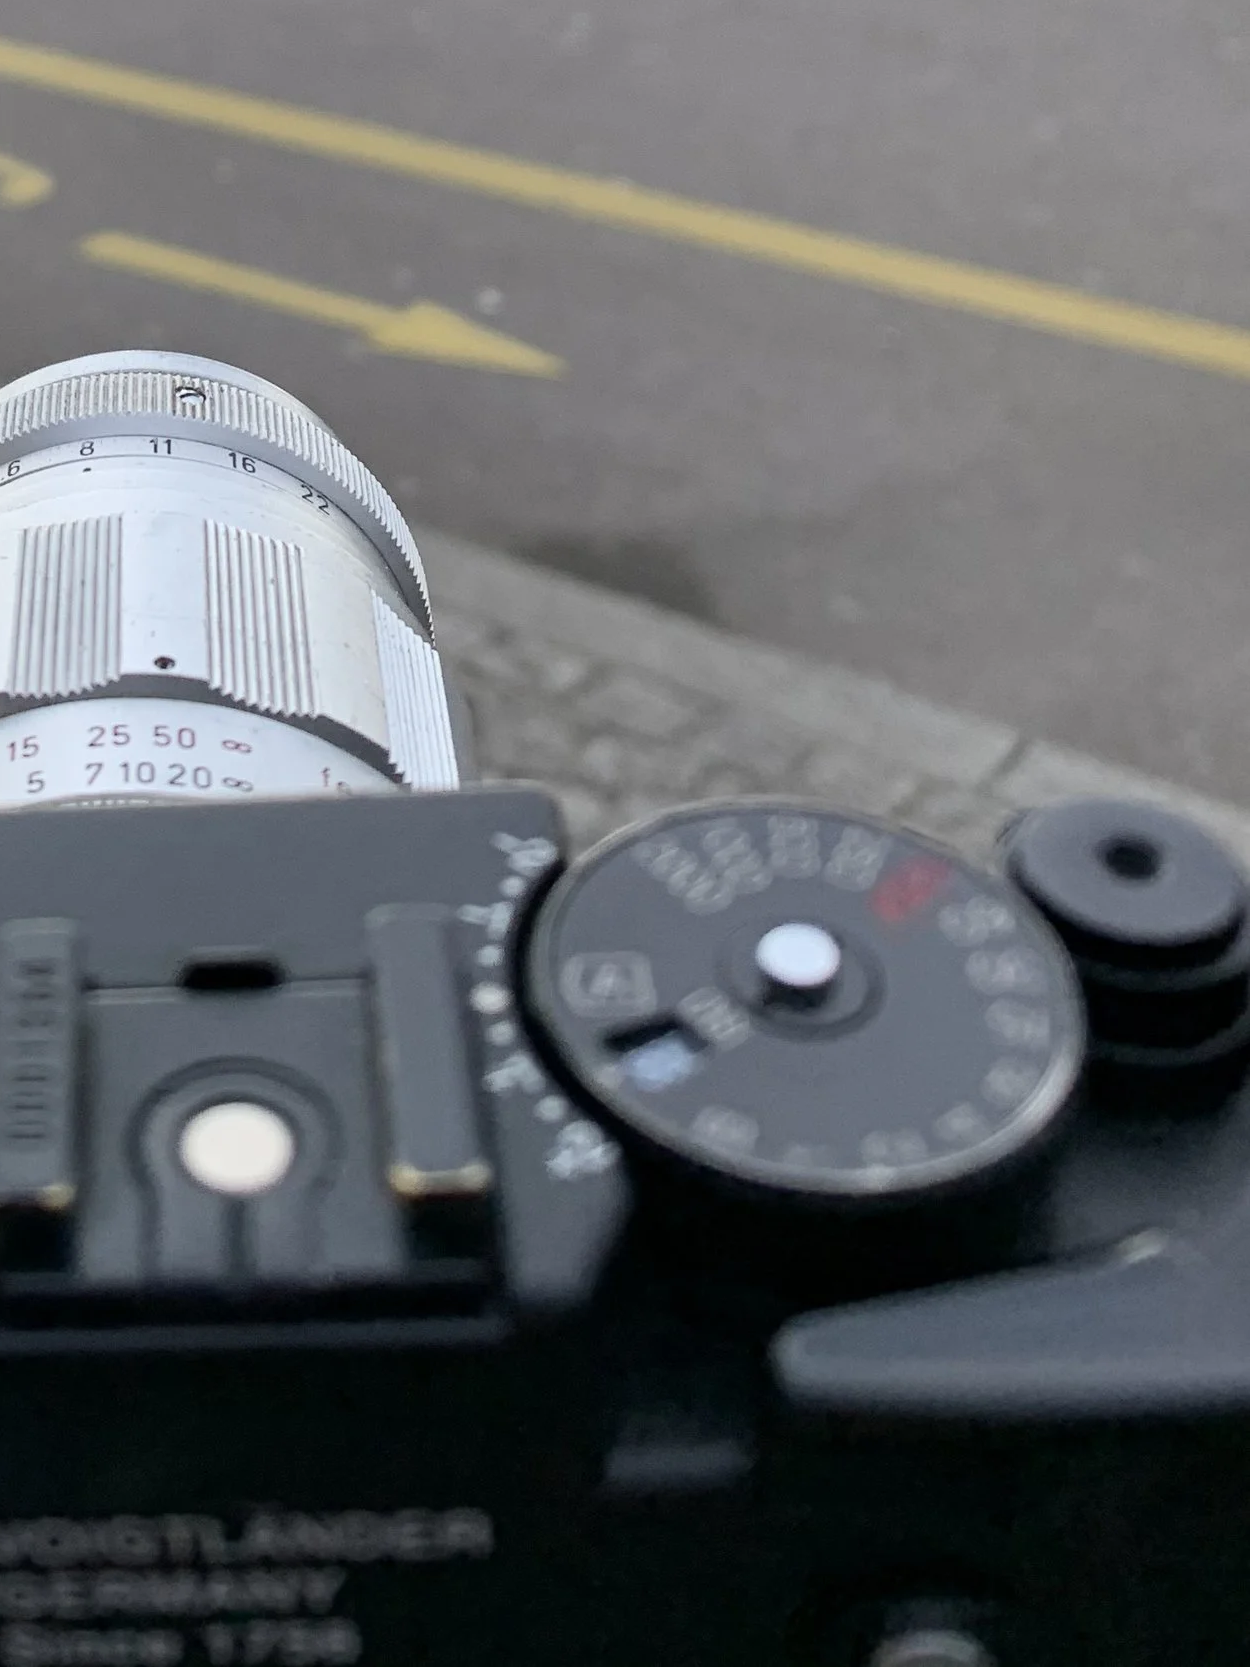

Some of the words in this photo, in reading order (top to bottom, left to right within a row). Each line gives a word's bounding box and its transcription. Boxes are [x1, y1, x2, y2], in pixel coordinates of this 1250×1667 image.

[79, 440, 95, 456] 8
[150, 438, 172, 455] 11
[228, 451, 257, 474] 16
[300, 484, 331, 516] 22
[7, 736, 40, 762] 15
[87, 725, 131, 748] 25
[153, 725, 197, 749] 50
[26, 770, 46, 794] 5
[84, 762, 104, 786] 7
[120, 761, 156, 784] 10
[168, 763, 213, 789] 20
